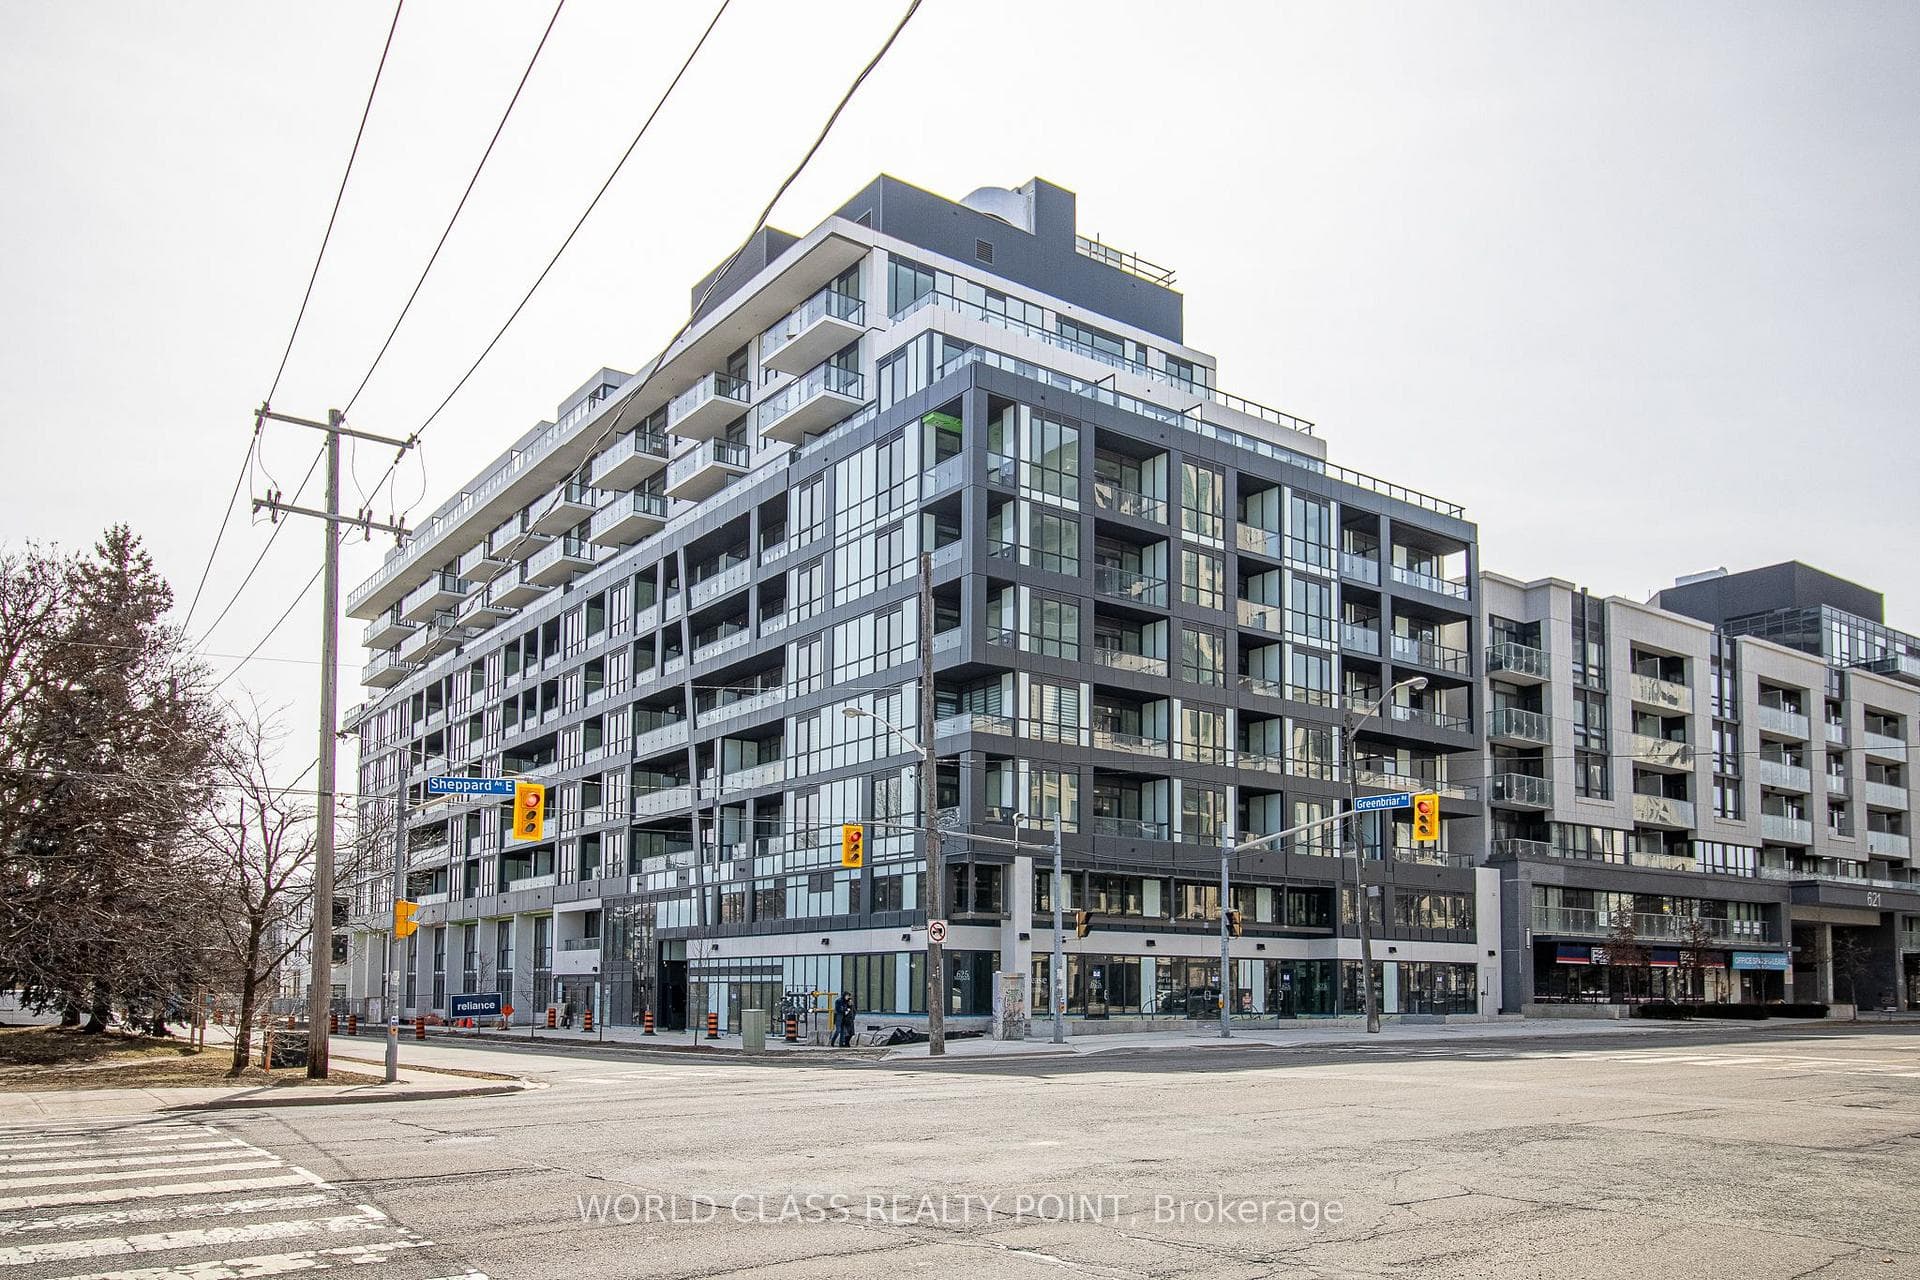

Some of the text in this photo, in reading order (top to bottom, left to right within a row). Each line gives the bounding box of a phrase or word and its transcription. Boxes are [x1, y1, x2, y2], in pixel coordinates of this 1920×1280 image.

[430, 777, 492, 792] Sheppard
[505, 780, 513, 792] E
[1357, 796, 1400, 809] Greenbriar
[1867, 891, 1881, 908] 621
[956, 970, 969, 978] 625
[457, 1001, 496, 1011] reliance
